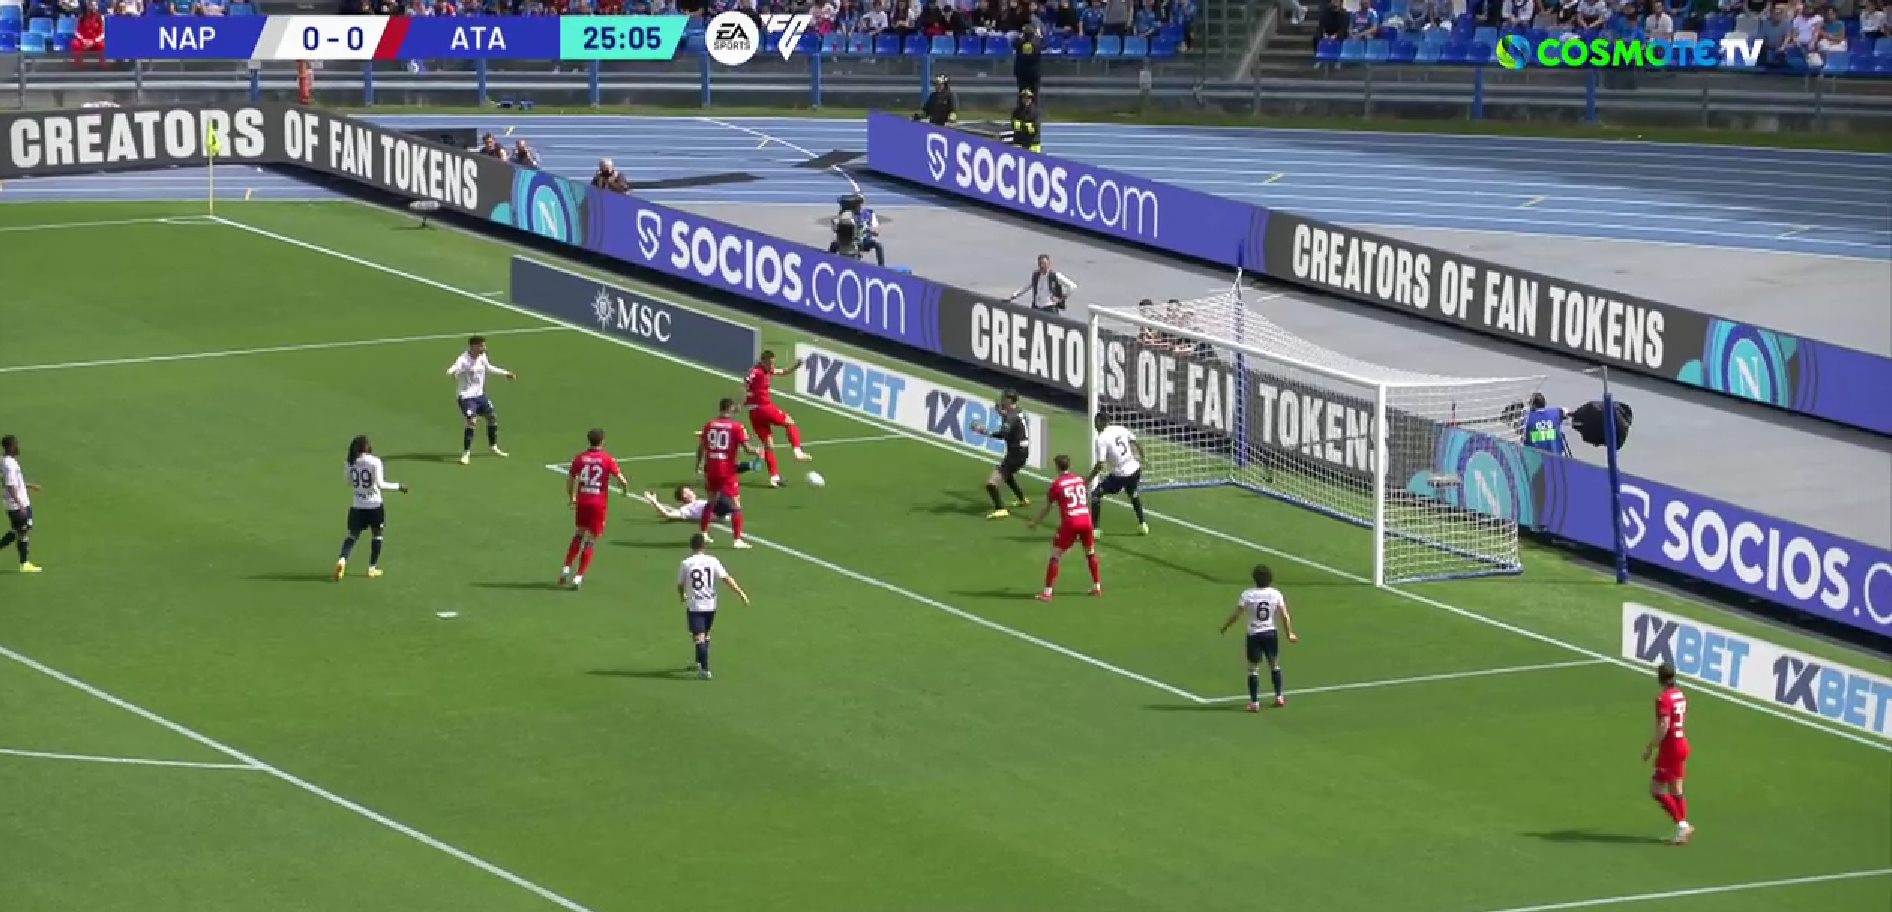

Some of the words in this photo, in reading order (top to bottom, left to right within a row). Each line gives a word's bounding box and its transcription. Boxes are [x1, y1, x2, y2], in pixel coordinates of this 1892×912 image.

[10, 107, 265, 168] CREATORS
[284, 109, 319, 163] OF
[329, 119, 373, 180] FAN
[380, 134, 478, 210] TOKENS
[955, 141, 1158, 239] SOCIOS.com
[670, 220, 906, 335] SOCIOS.com
[1293, 223, 1430, 309] CREATORS
[1439, 259, 1475, 319] OF
[1484, 268, 1538, 339] FAN
[1549, 287, 1666, 369] TOKENS
[616, 296, 672, 342] MSC
[805, 353, 906, 420] 1XBET
[1136, 349, 1176, 414] OF
[707, 429, 730, 451] 90
[1115, 436, 1128, 456] 5
[350, 467, 372, 489] 99
[580, 464, 603, 487] 42
[1063, 484, 1087, 508] 59
[691, 566, 712, 591] 81
[1256, 601, 1270, 621] 6
[1634, 612, 1750, 689] 1XBET
